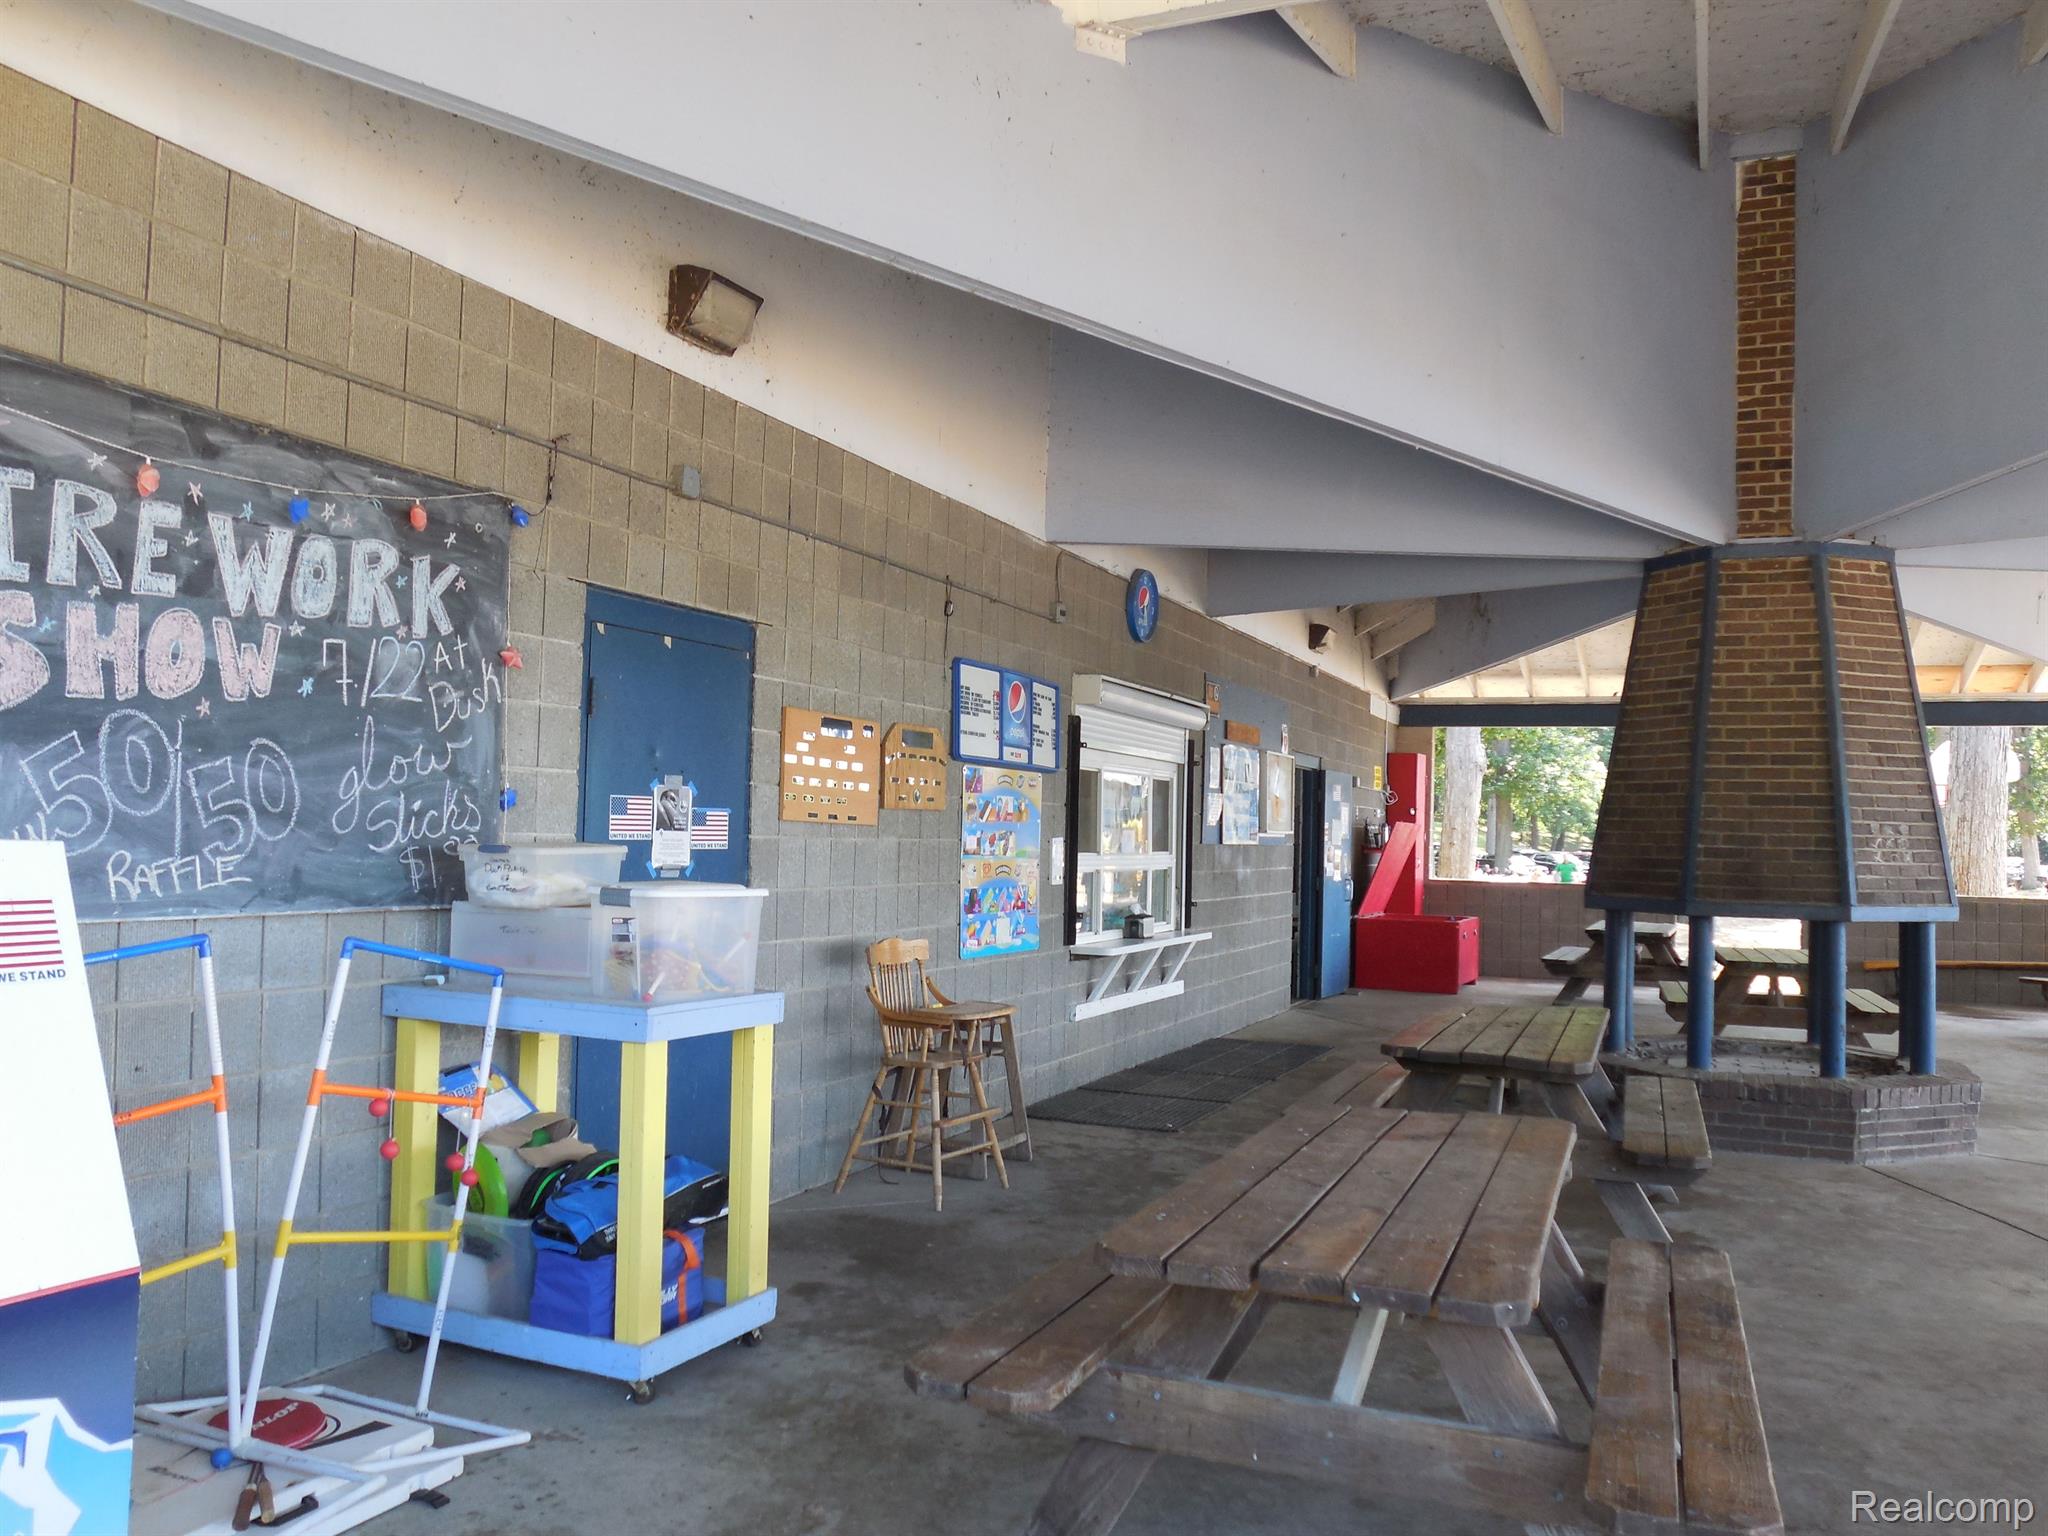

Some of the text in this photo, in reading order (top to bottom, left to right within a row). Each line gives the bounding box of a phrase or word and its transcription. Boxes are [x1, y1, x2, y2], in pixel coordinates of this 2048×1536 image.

[0, 589, 282, 707] SHOW
[332, 715, 472, 834] glow
[106, 850, 252, 900] RAFFLE
[19, 968, 66, 982] STAND
